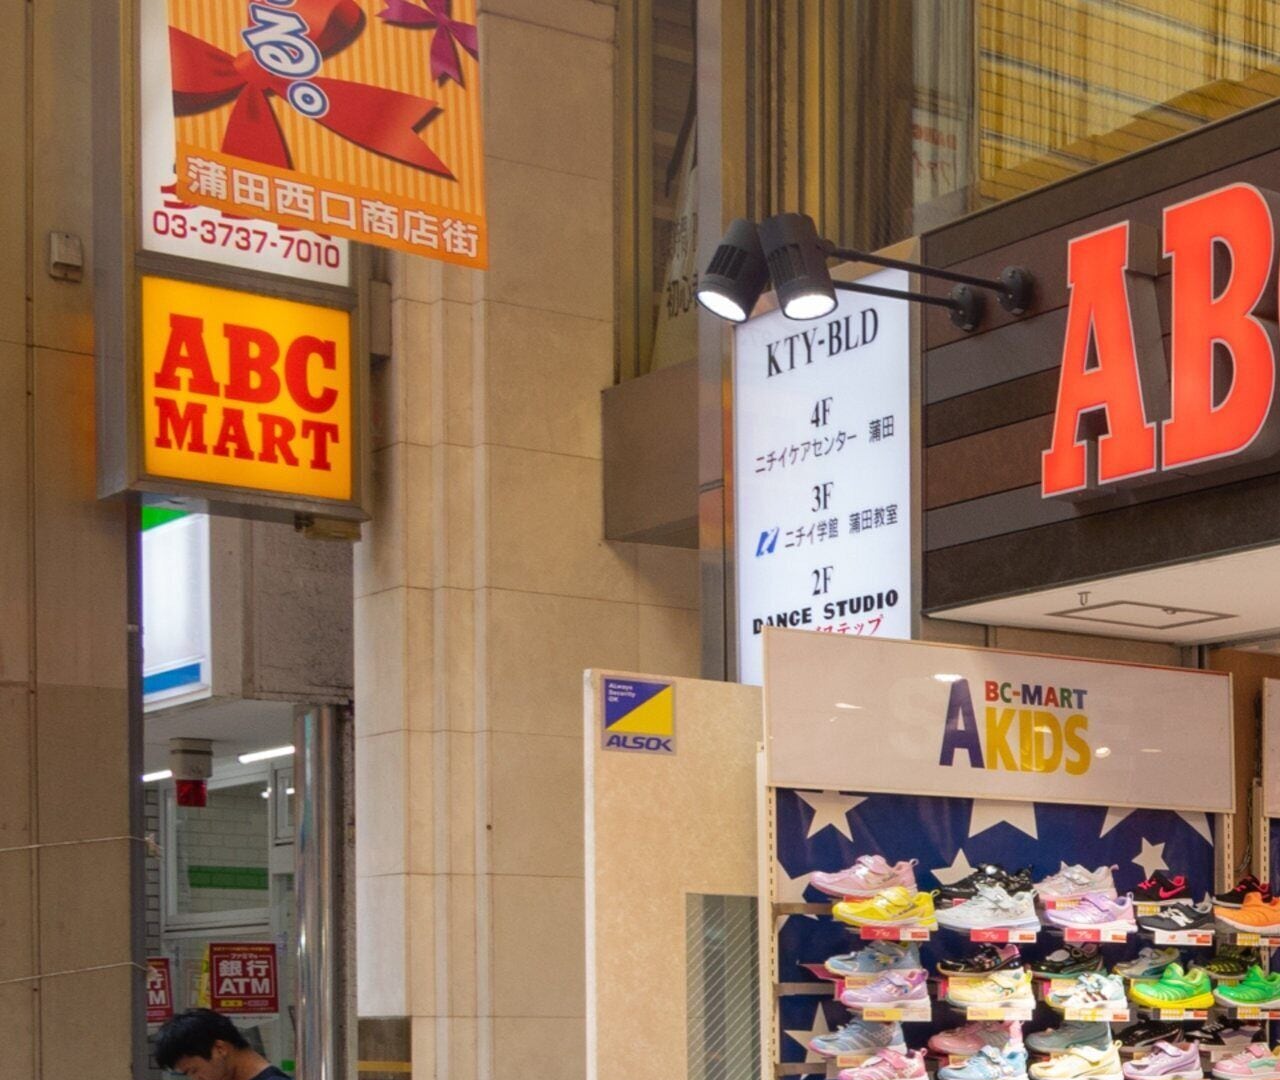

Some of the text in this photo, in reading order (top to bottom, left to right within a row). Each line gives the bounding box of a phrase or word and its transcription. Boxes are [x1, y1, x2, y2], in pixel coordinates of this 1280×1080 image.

[187, 155, 478, 258] 蒲田西口商店街
[153, 210, 340, 268] 03-3737-7010
[154, 312, 338, 413] ABC
[766, 306, 880, 379] KTY-BLD
[154, 397, 340, 472] MART
[810, 397, 834, 429] 4F
[754, 414, 895, 474] ニチイケアセンター 蒲田
[811, 481, 835, 513] 3F
[784, 503, 899, 549] ニチイ学館 蒲田教室
[811, 566, 834, 596] 2F
[752, 589, 899, 635] DANCE STUDIO
[606, 735, 673, 752] ALSOK
[984, 707, 1092, 776] KIDS
[218, 960, 270, 977] 銀行
[219, 978, 270, 994] ATM
